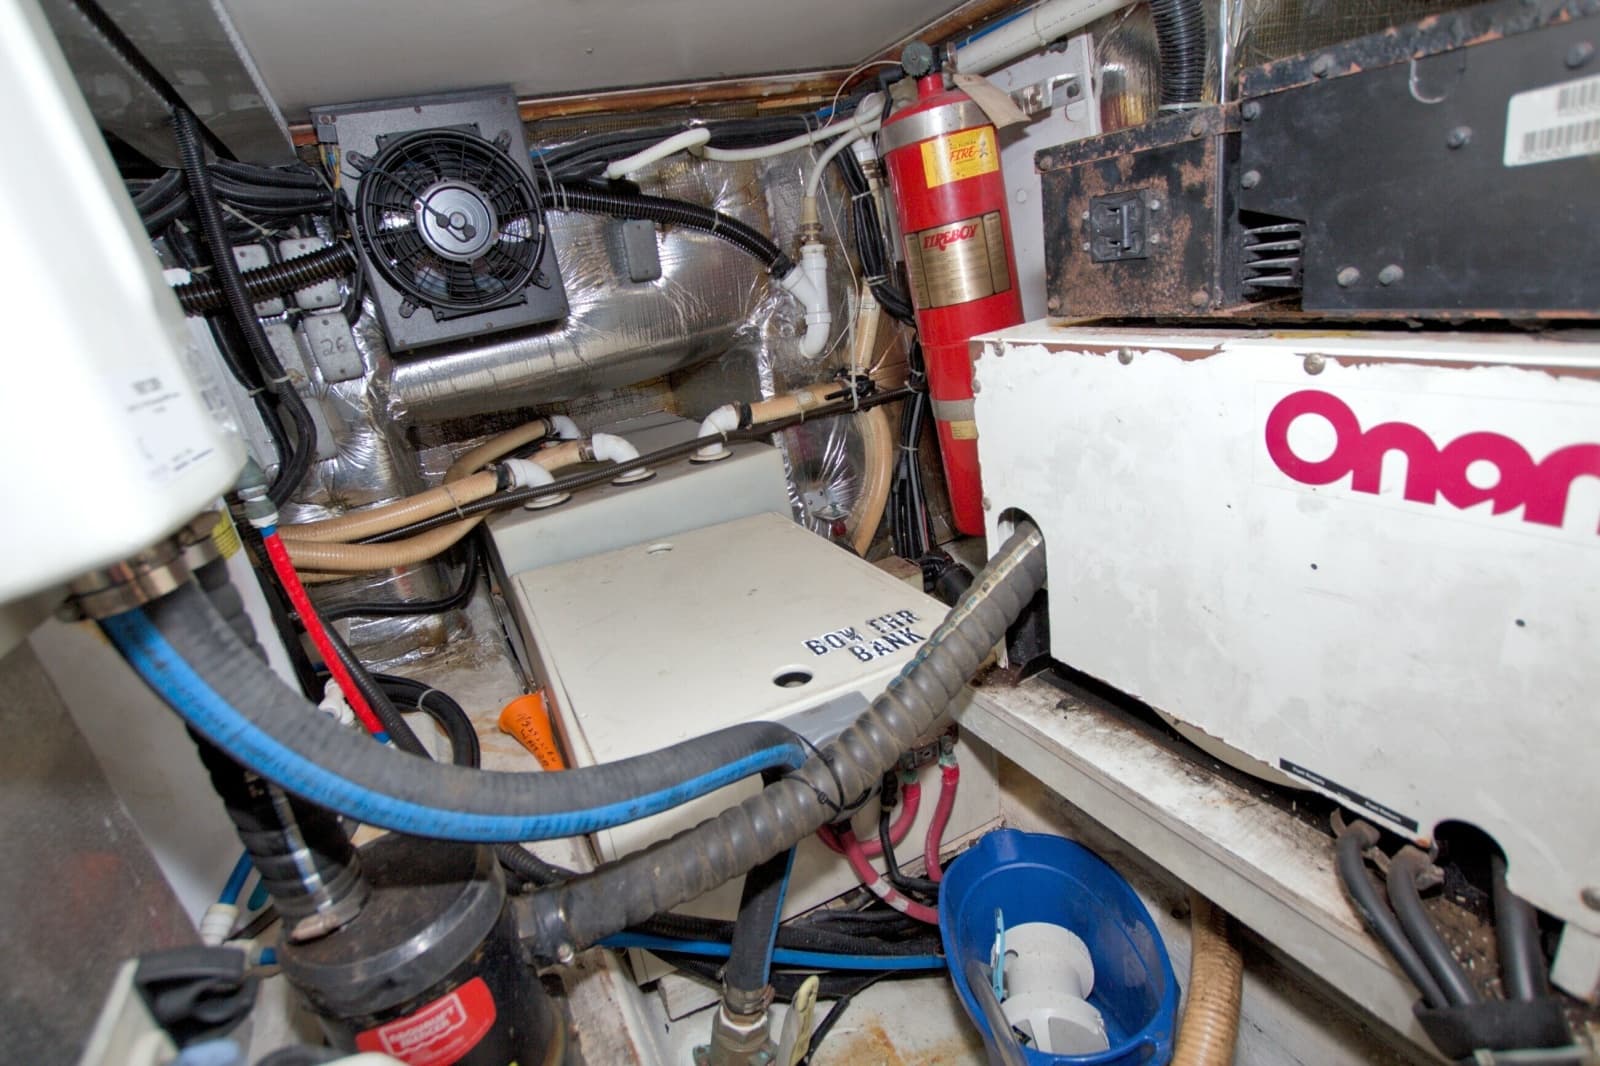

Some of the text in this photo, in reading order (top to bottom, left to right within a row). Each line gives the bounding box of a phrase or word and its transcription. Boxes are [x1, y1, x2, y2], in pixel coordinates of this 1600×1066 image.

[923, 223, 979, 251] FIREBOY
[320, 336, 347, 358] 26
[804, 626, 864, 656] BOW
[848, 627, 927, 663] BANK
